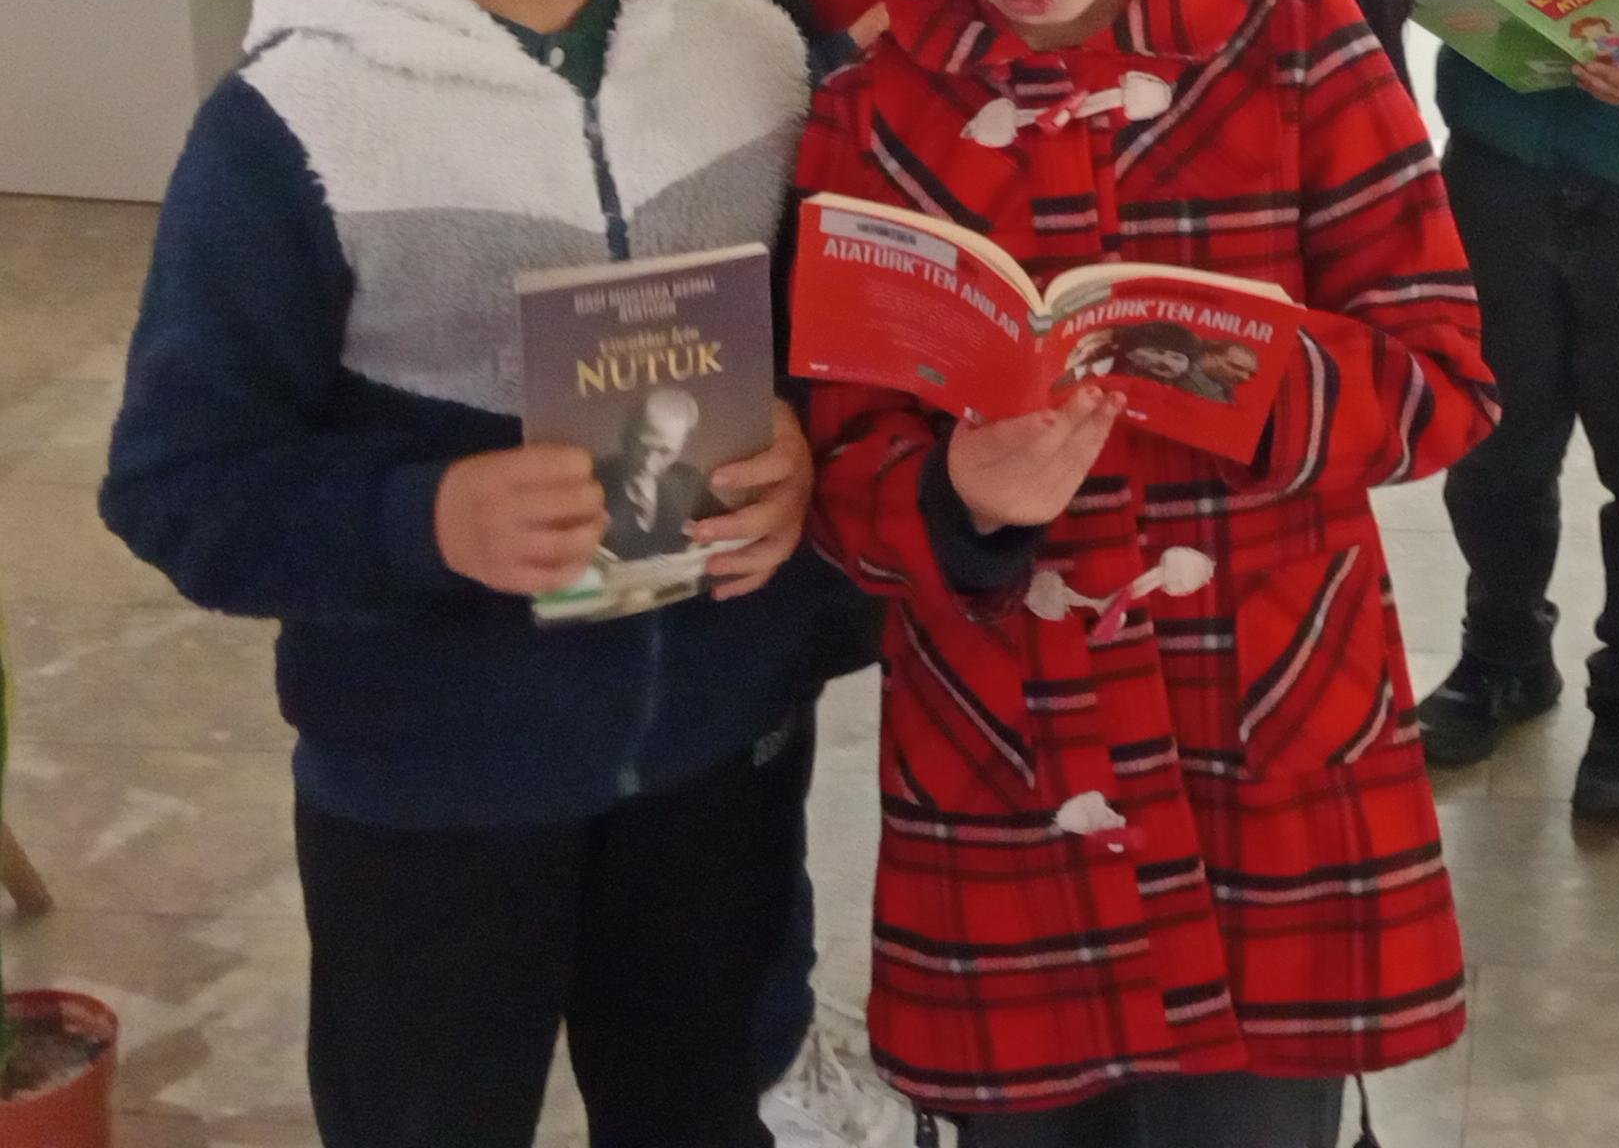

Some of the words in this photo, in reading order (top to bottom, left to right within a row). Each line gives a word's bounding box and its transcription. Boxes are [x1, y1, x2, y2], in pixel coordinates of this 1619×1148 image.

[960, 283, 1020, 343] ANILAR
[1198, 308, 1274, 344] ANILAR
[576, 341, 723, 398] NUTUK
